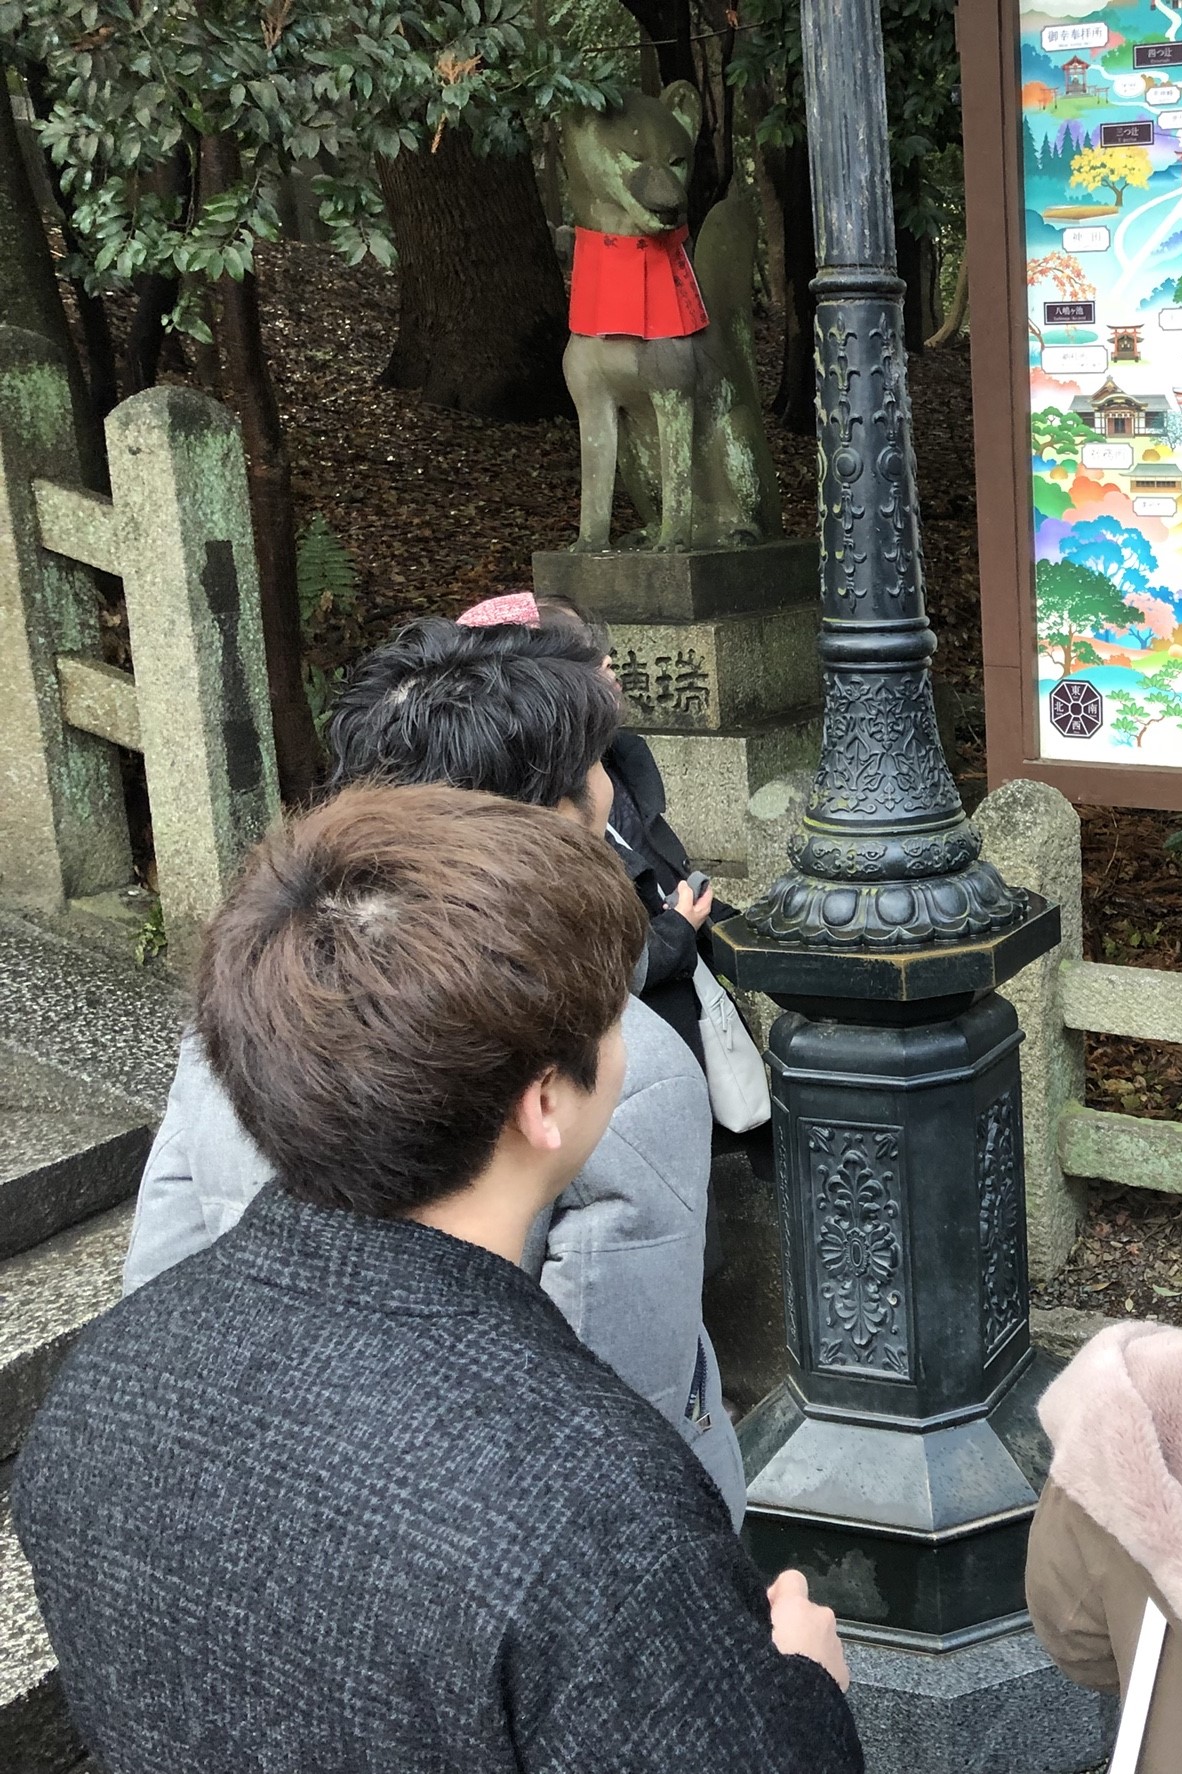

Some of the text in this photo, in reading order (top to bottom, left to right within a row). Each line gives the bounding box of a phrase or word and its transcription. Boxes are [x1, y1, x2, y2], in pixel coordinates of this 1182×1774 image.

[1071, 684, 1081, 697] 東
[1054, 701, 1065, 713] 北
[1087, 703, 1098, 715] 南
[1071, 720, 1082, 731] 西
